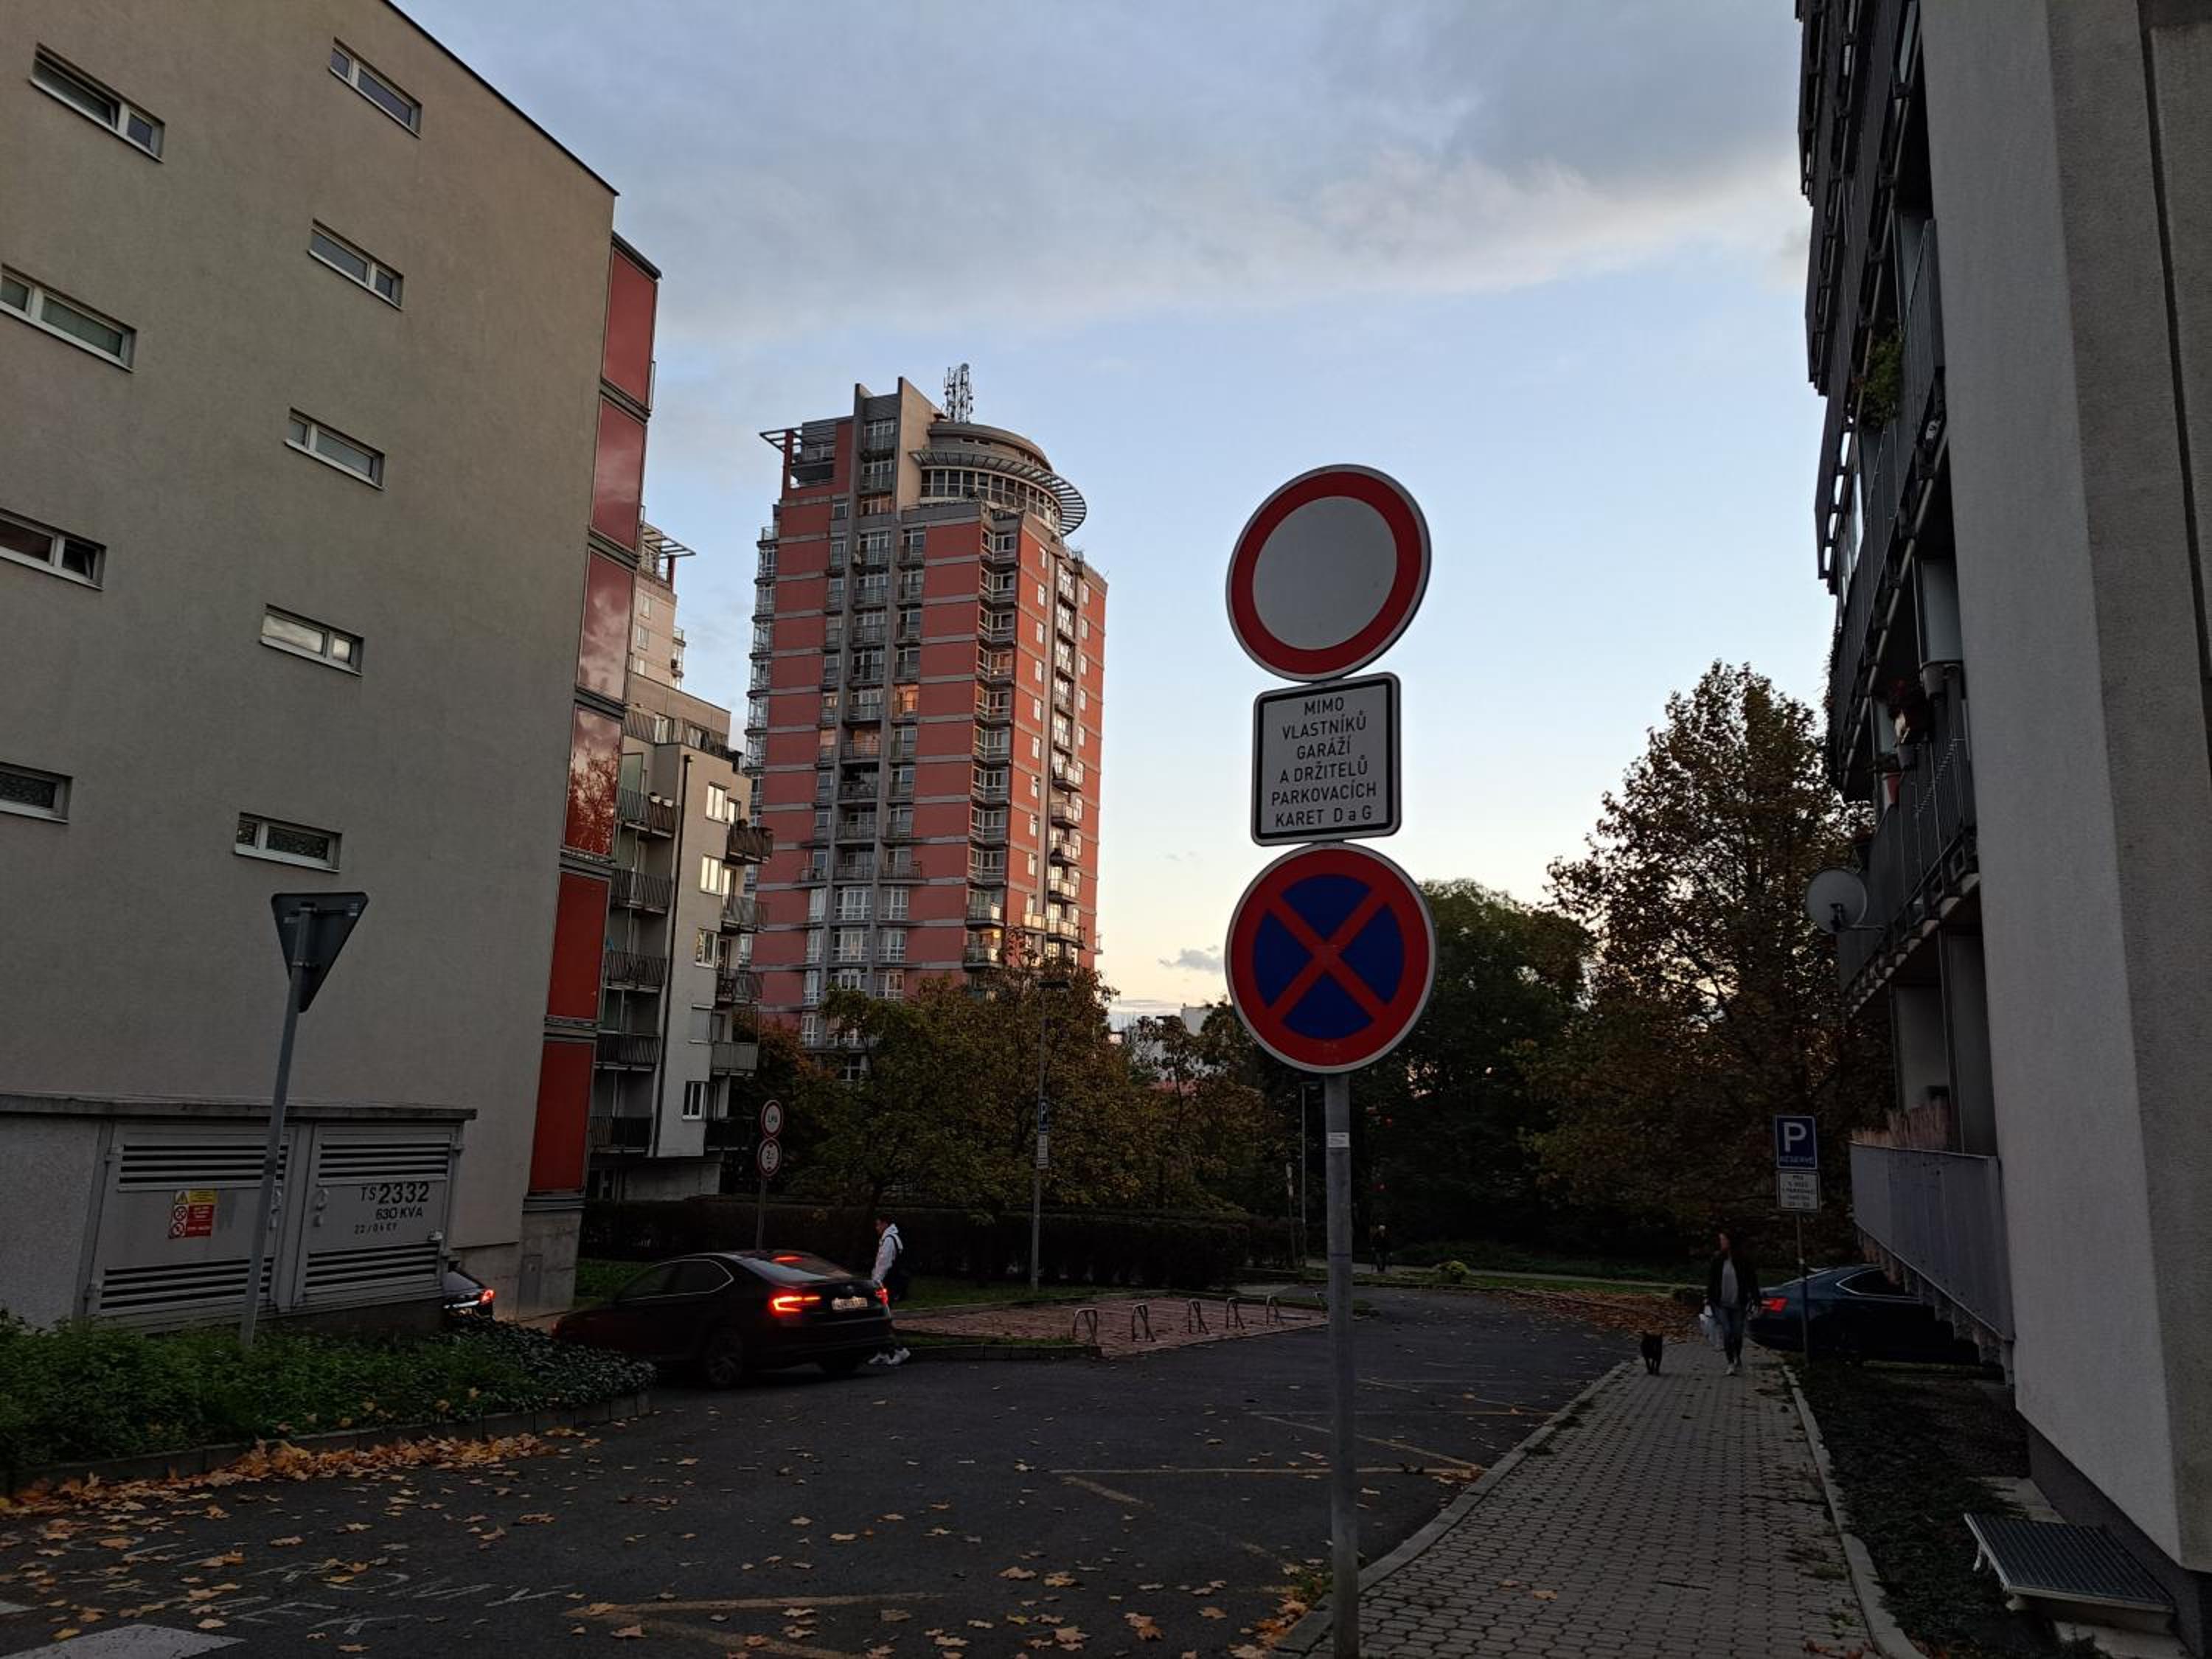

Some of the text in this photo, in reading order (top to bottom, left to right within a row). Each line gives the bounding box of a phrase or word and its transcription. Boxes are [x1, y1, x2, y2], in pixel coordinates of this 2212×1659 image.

[1304, 697, 1344, 715] MIMO
[1282, 710, 1366, 740] VLASTNÍKŮ
[1296, 736, 1351, 759] GARÁŽÍ
[1279, 755, 1368, 784] A DRŽITELŮ
[1271, 780, 1377, 806] PARKOVACÍCH
[1276, 805, 1371, 827] KARET D a G
[1782, 1121, 1807, 1153] P
[378, 1181, 429, 1204] 2332
[376, 1205, 423, 1220] 630 KVA
